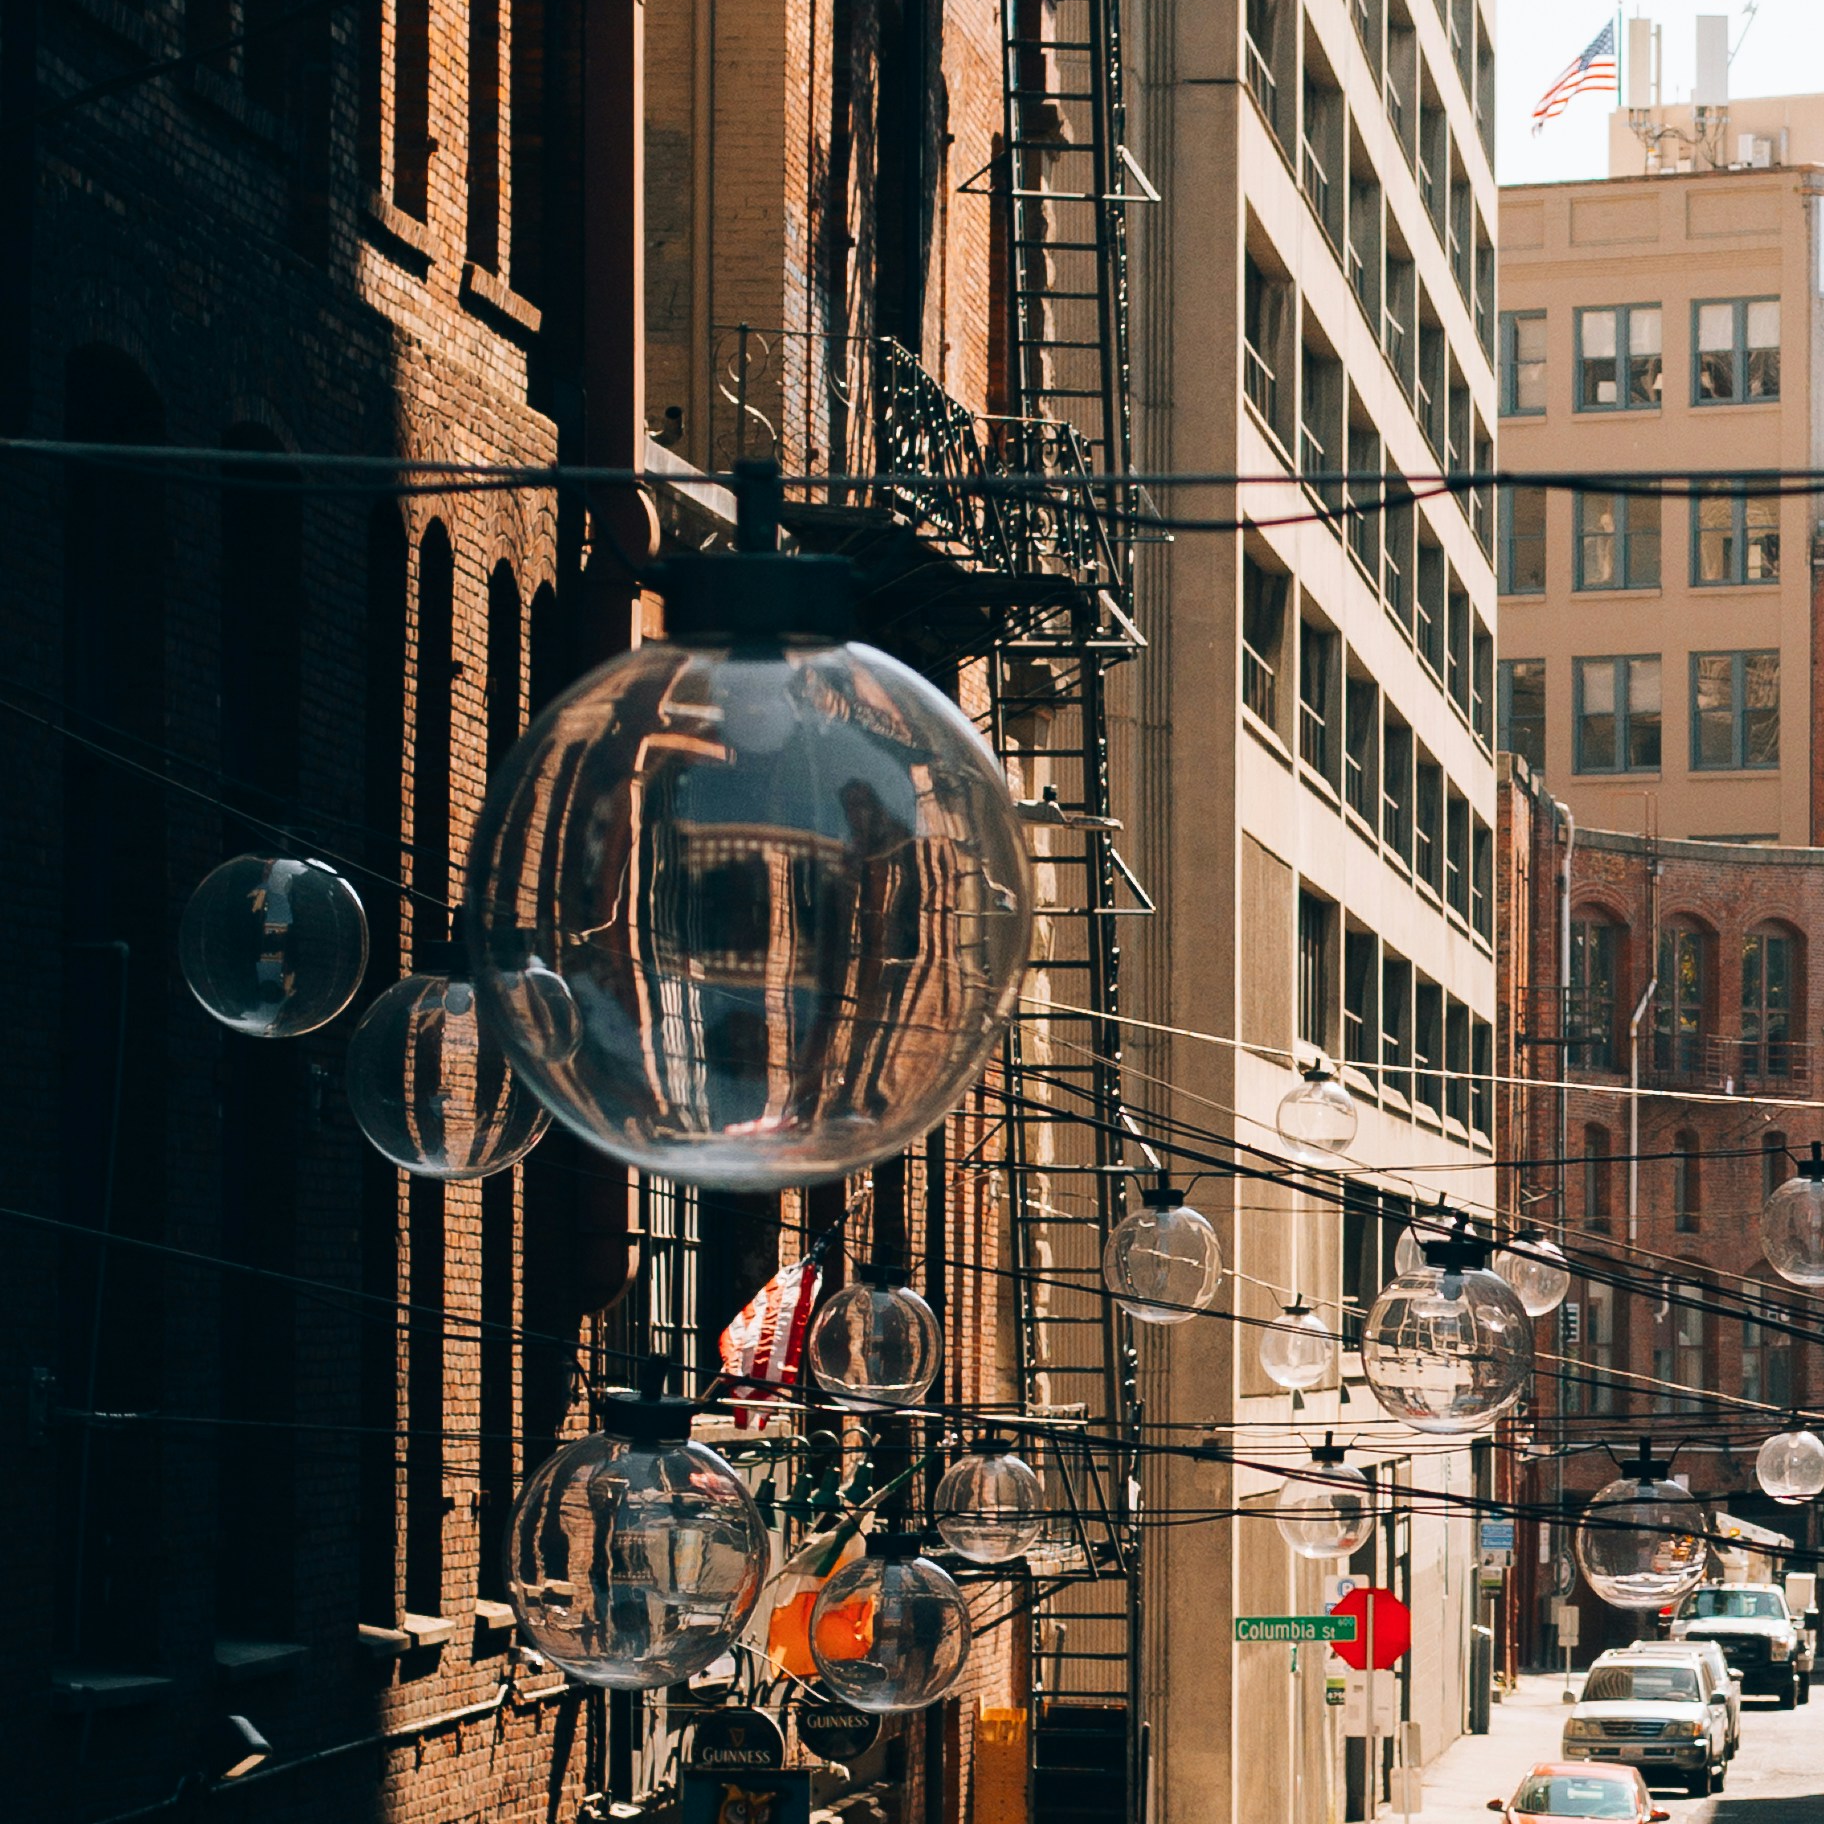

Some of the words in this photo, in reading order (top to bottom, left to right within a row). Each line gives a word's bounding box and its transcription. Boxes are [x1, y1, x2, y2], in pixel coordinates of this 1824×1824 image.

[1237, 1620, 1316, 1640] Columbia
[1322, 1627, 1336, 1639] St
[807, 1713, 870, 1730] GUINNESS
[702, 1746, 771, 1765] GUINNESS
